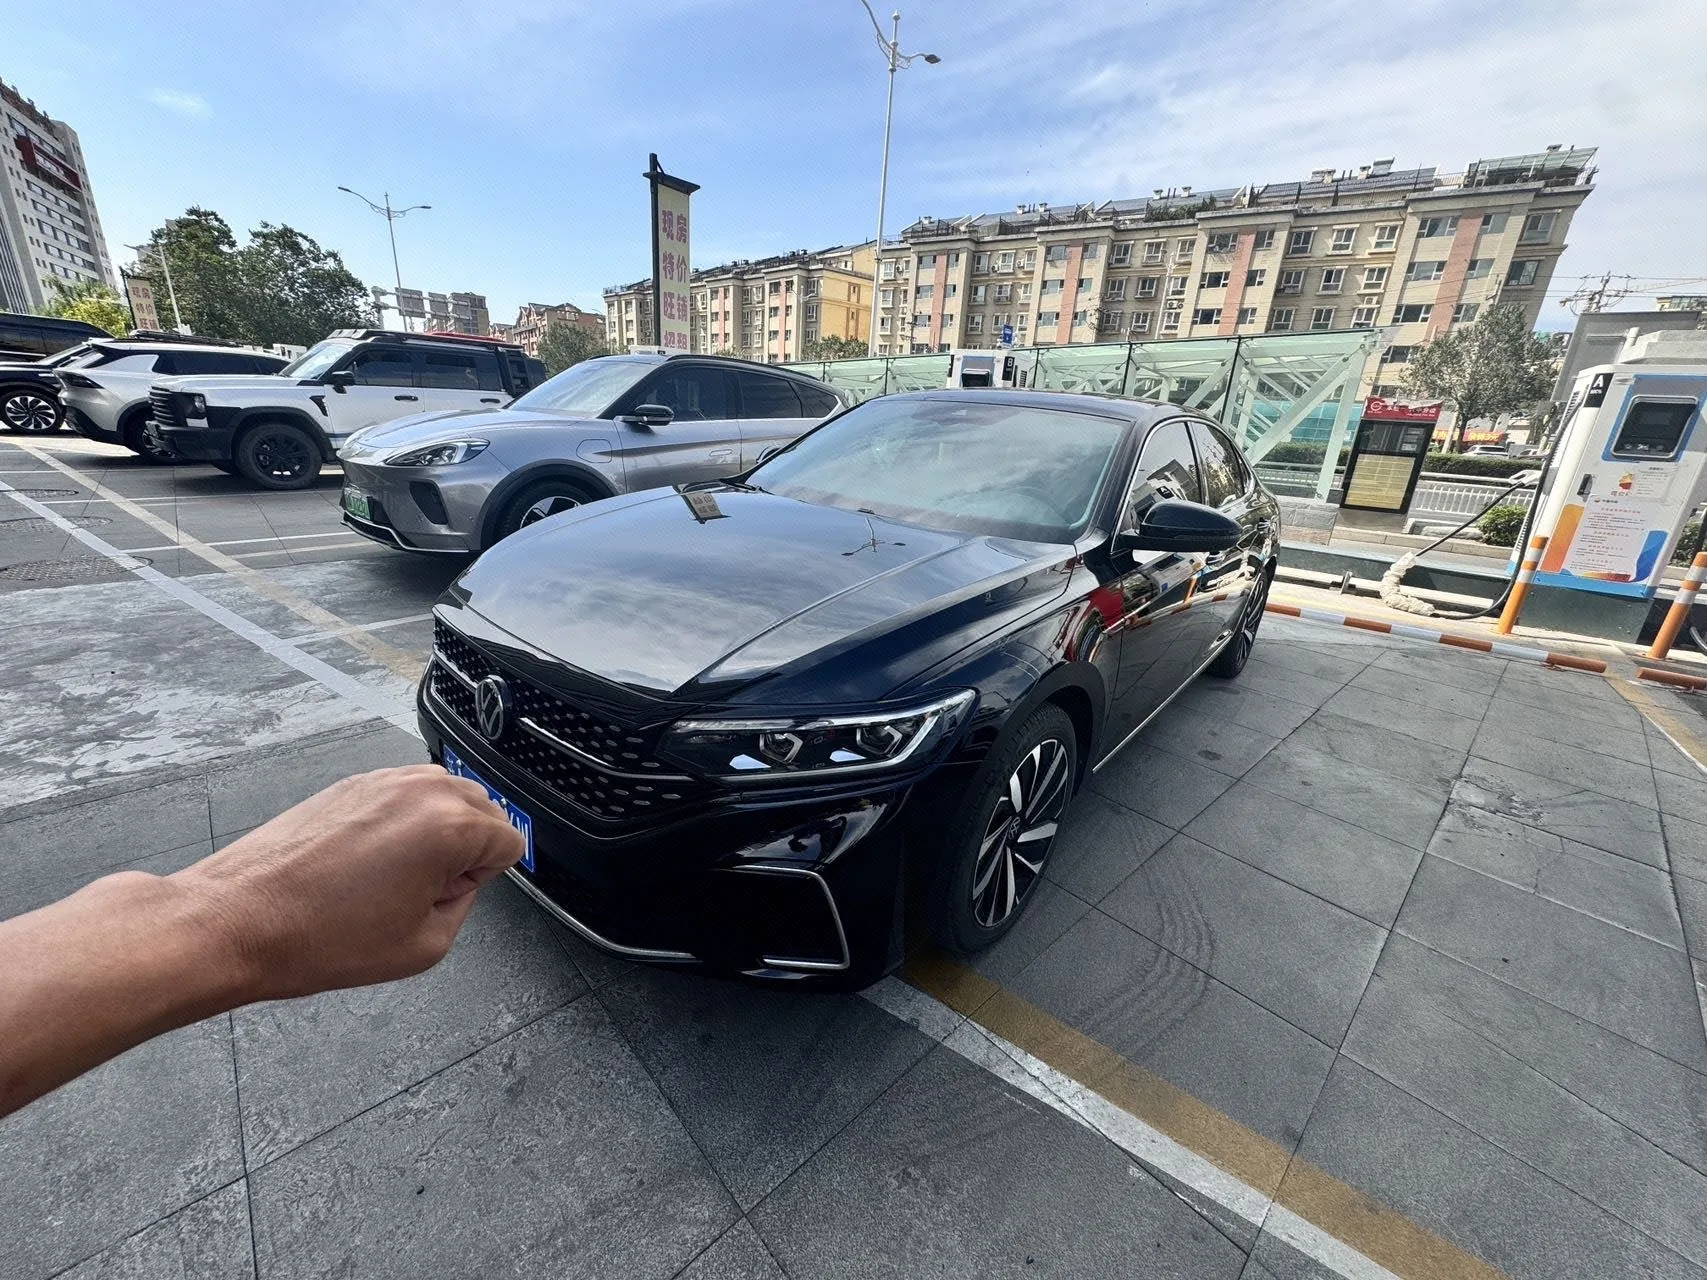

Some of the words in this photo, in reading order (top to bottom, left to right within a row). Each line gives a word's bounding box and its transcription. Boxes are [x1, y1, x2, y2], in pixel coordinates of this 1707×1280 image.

[662, 210, 687, 243] 现房
[663, 251, 687, 283] 特价
[664, 292, 687, 321] 旺铺
[1592, 374, 1604, 388] A
